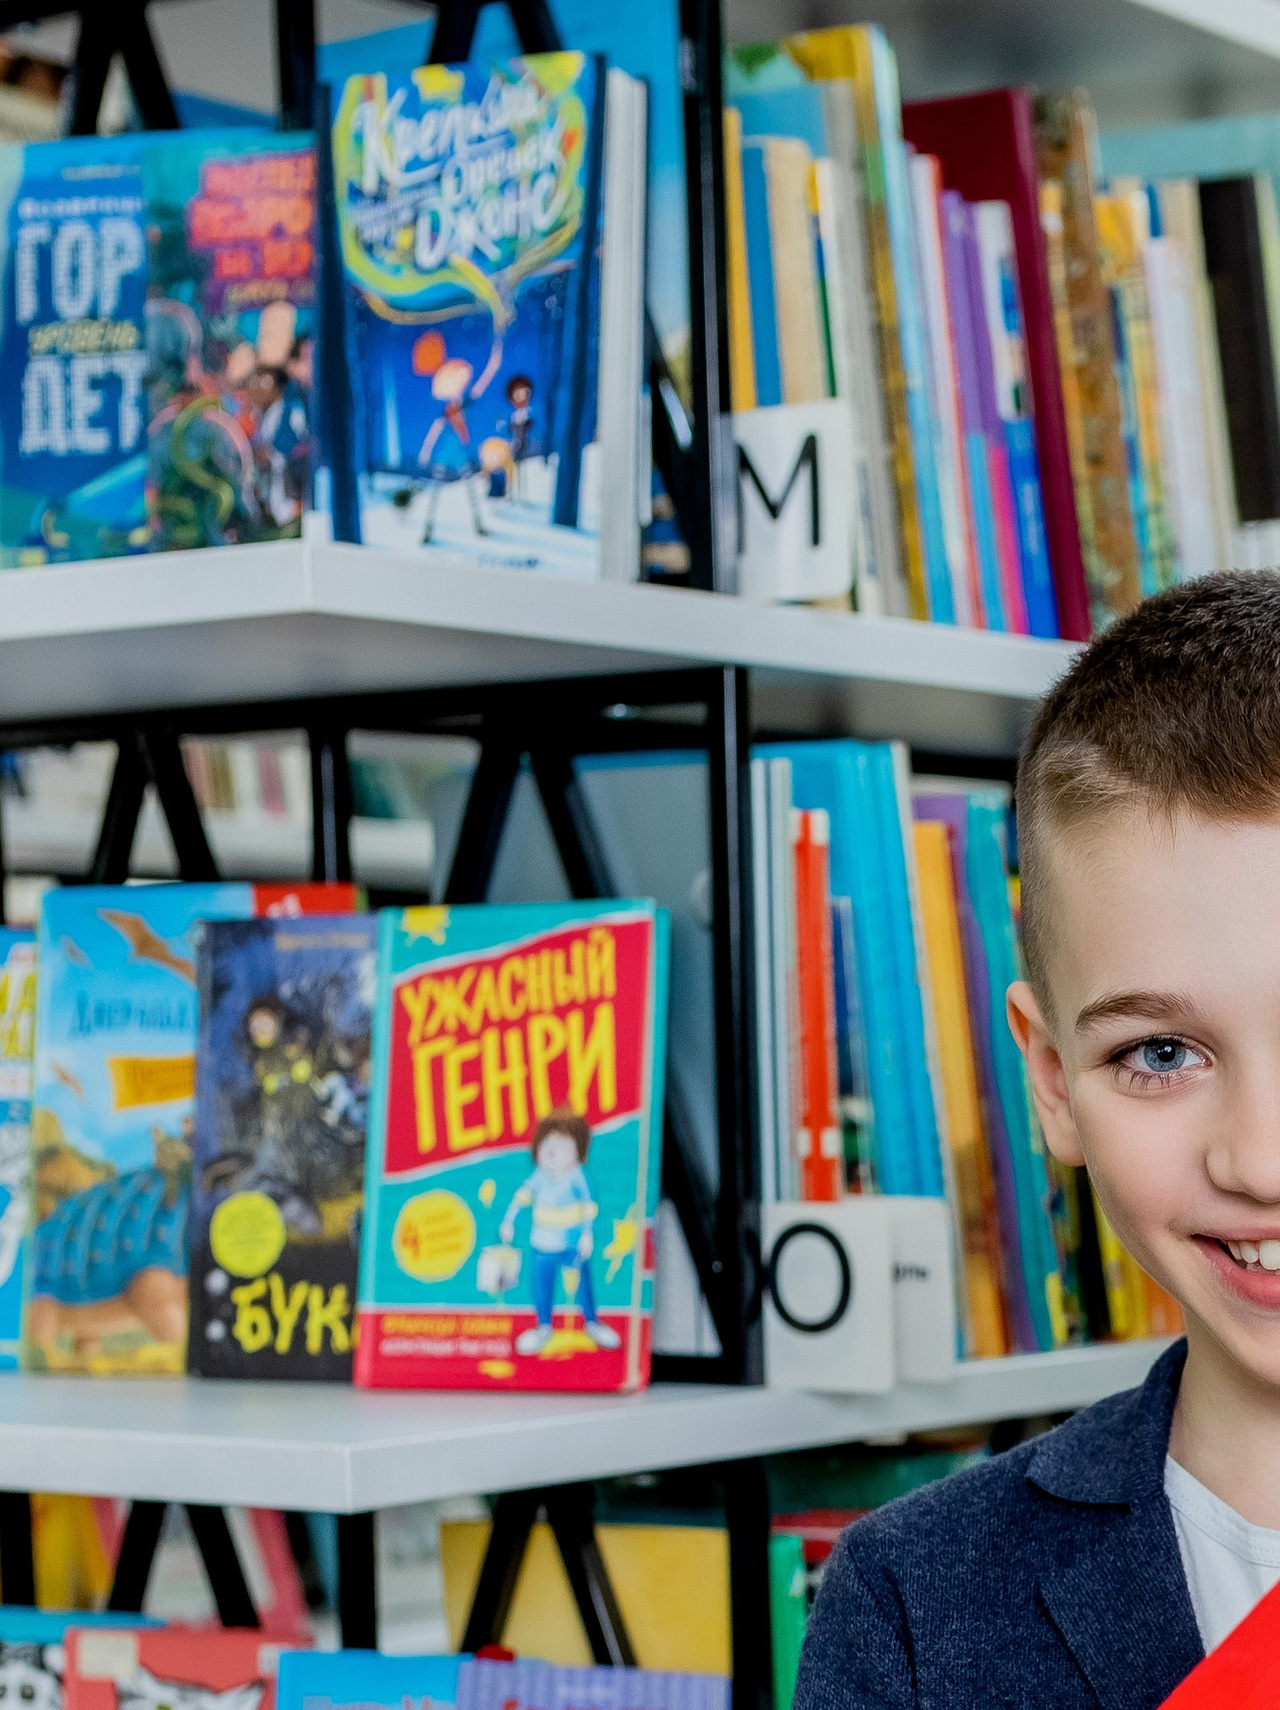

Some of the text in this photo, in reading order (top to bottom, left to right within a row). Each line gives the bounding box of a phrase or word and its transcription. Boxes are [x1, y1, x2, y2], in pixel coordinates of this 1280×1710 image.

[735, 432, 820, 552] М
[400, 926, 617, 1049] УЖАСНЫЙ
[411, 1001, 618, 1156] ГЕНРИ
